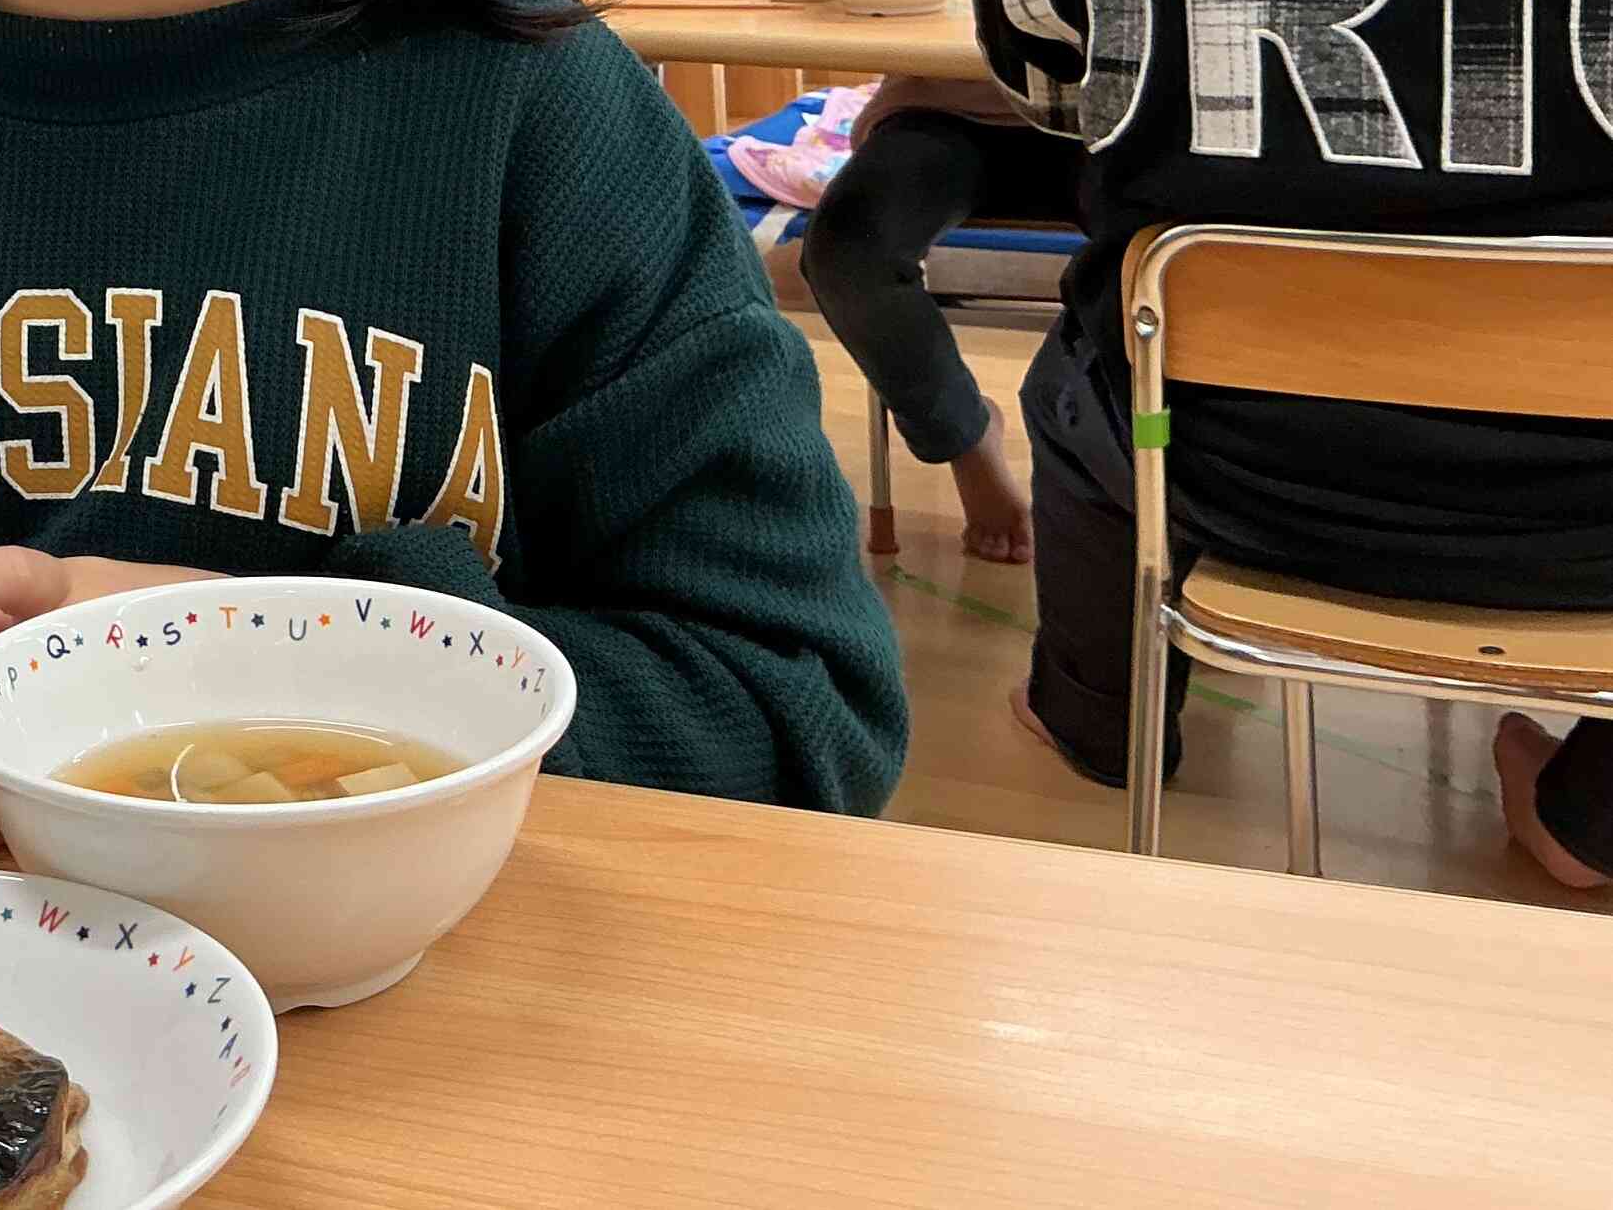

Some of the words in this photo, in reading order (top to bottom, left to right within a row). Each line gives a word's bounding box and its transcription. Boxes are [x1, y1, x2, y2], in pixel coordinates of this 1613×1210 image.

[7, 666, 18, 690] P
[47, 634, 71, 659] Q
[106, 624, 124, 649] R
[163, 622, 181, 645] S
[219, 606, 237, 629] T
[289, 618, 307, 641] U
[355, 598, 372, 622] V
[409, 610, 434, 639] W
[470, 630, 484, 656] X
[511, 645, 526, 668] Y
[534, 668, 545, 692] Z
[39, 900, 70, 933] W
[115, 922, 137, 950] X
[172, 946, 195, 972] Y
[207, 977, 231, 1004] Z
